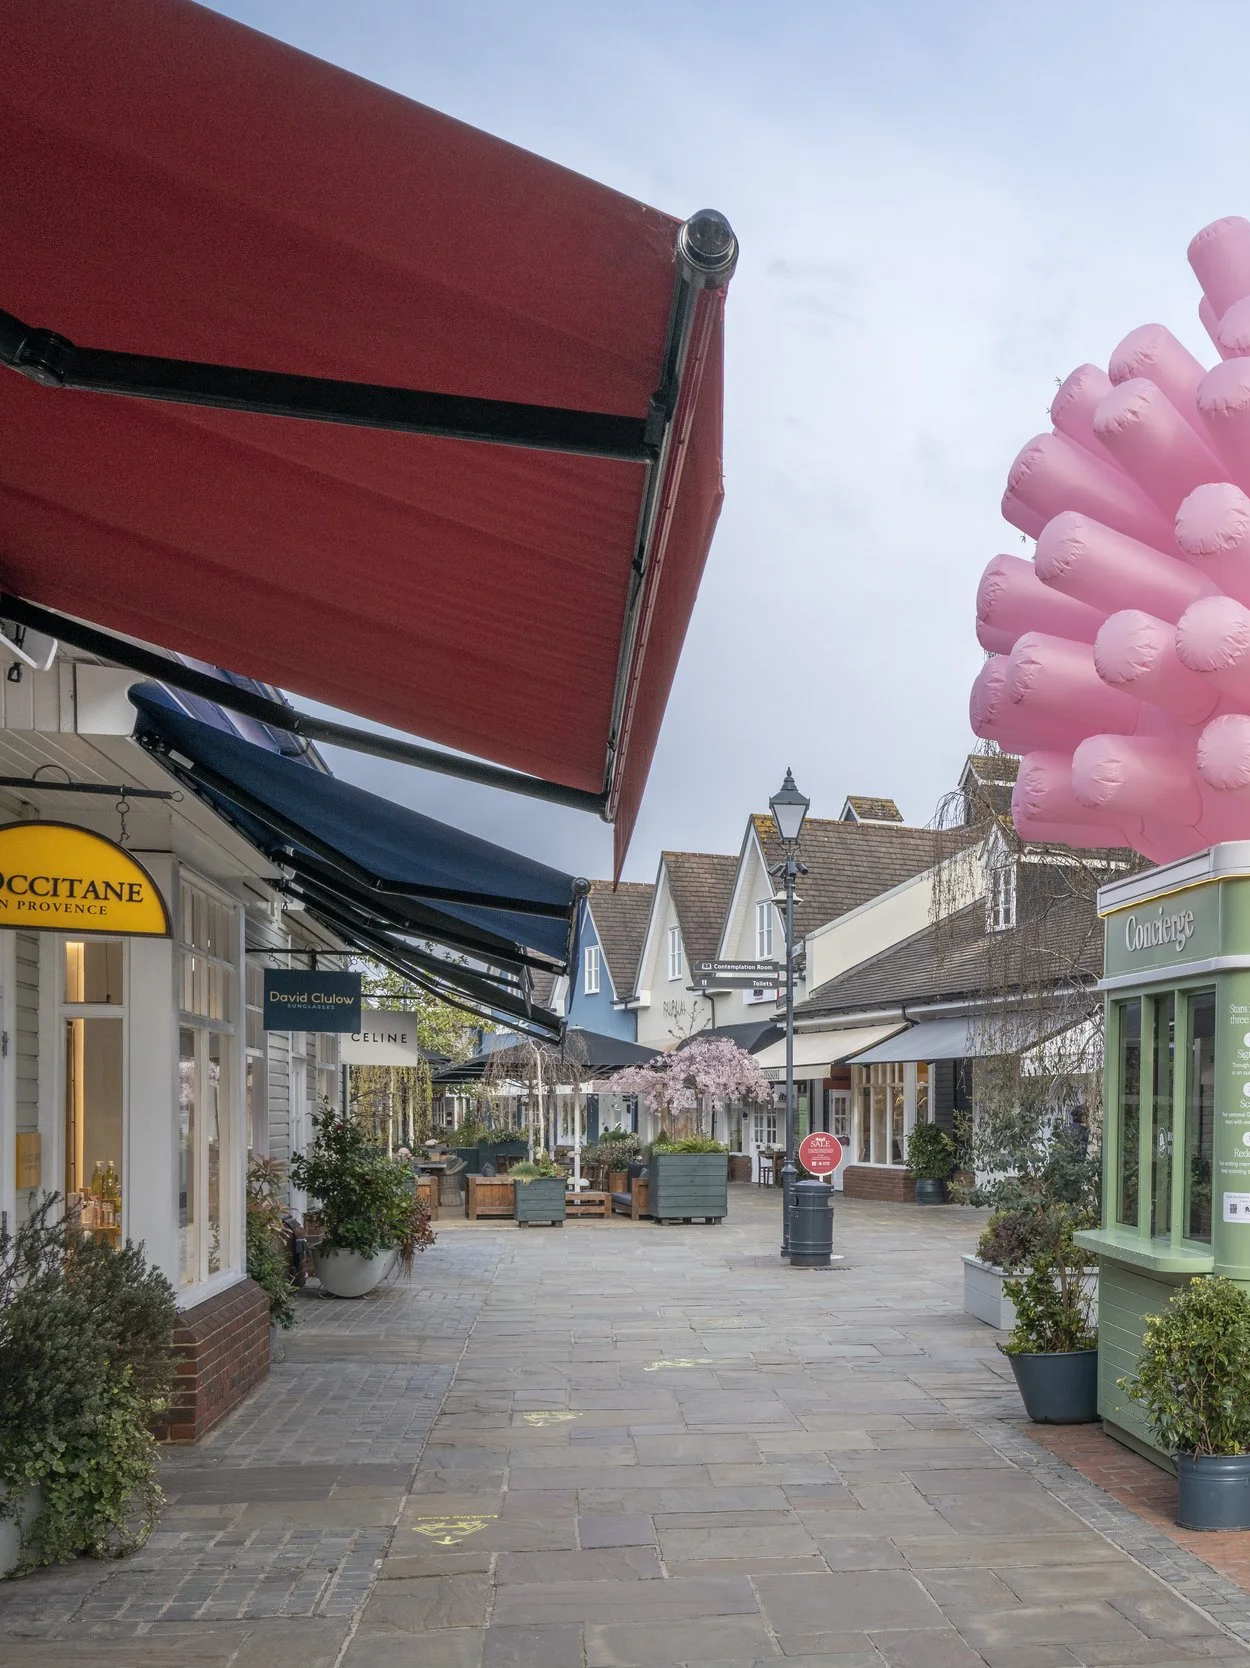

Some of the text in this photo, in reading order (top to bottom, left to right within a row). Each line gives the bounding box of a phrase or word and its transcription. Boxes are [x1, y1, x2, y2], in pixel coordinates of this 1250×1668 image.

[0, 872, 144, 903] CCITANE
[0, 900, 107, 915] N PROVENCE
[1125, 906, 1194, 952] Concierge
[714, 963, 773, 971] Contemplation Room
[269, 991, 354, 1005] David Clulow
[1229, 1003, 1247, 1014] Stars
[1230, 1014, 1249, 1025] three
[351, 1032, 408, 1043] CELINE
[810, 1140, 831, 1148] SALE
